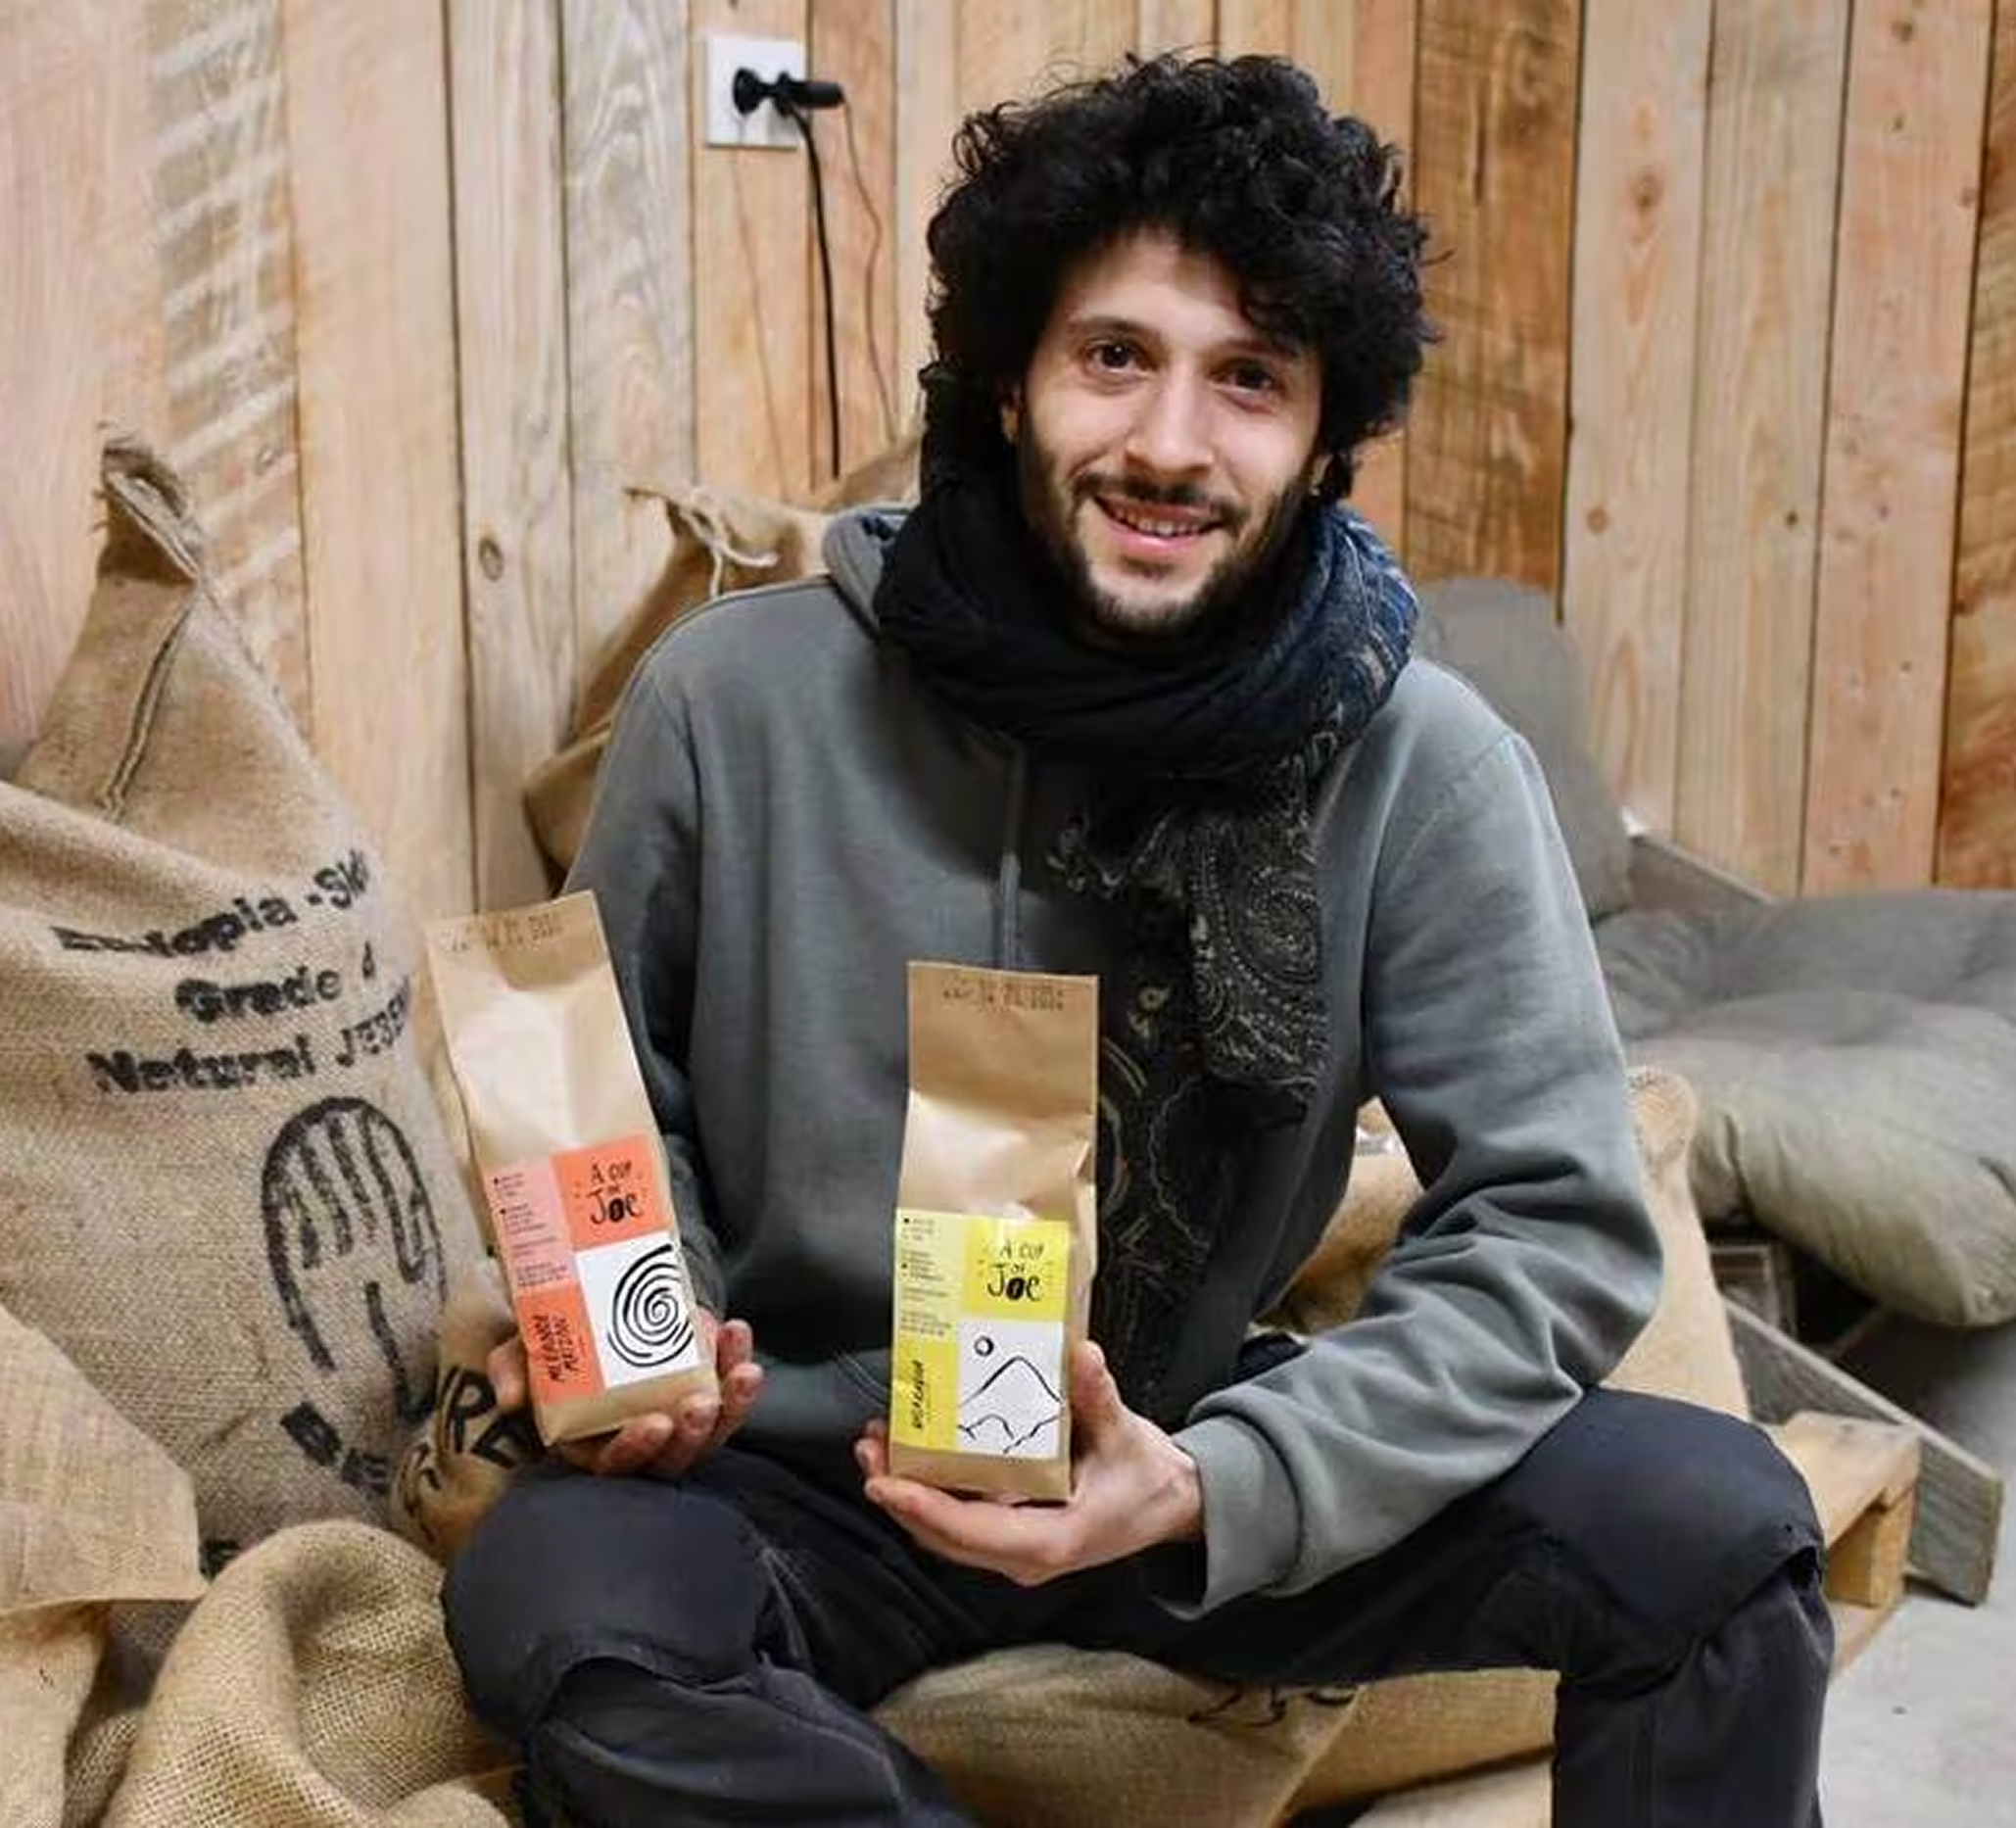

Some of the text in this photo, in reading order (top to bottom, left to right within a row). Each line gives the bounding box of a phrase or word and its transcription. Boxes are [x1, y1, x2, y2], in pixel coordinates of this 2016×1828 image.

[174, 964, 342, 1024] Grade
[590, 1162, 604, 1185] A
[1000, 1239, 1012, 1260] A
